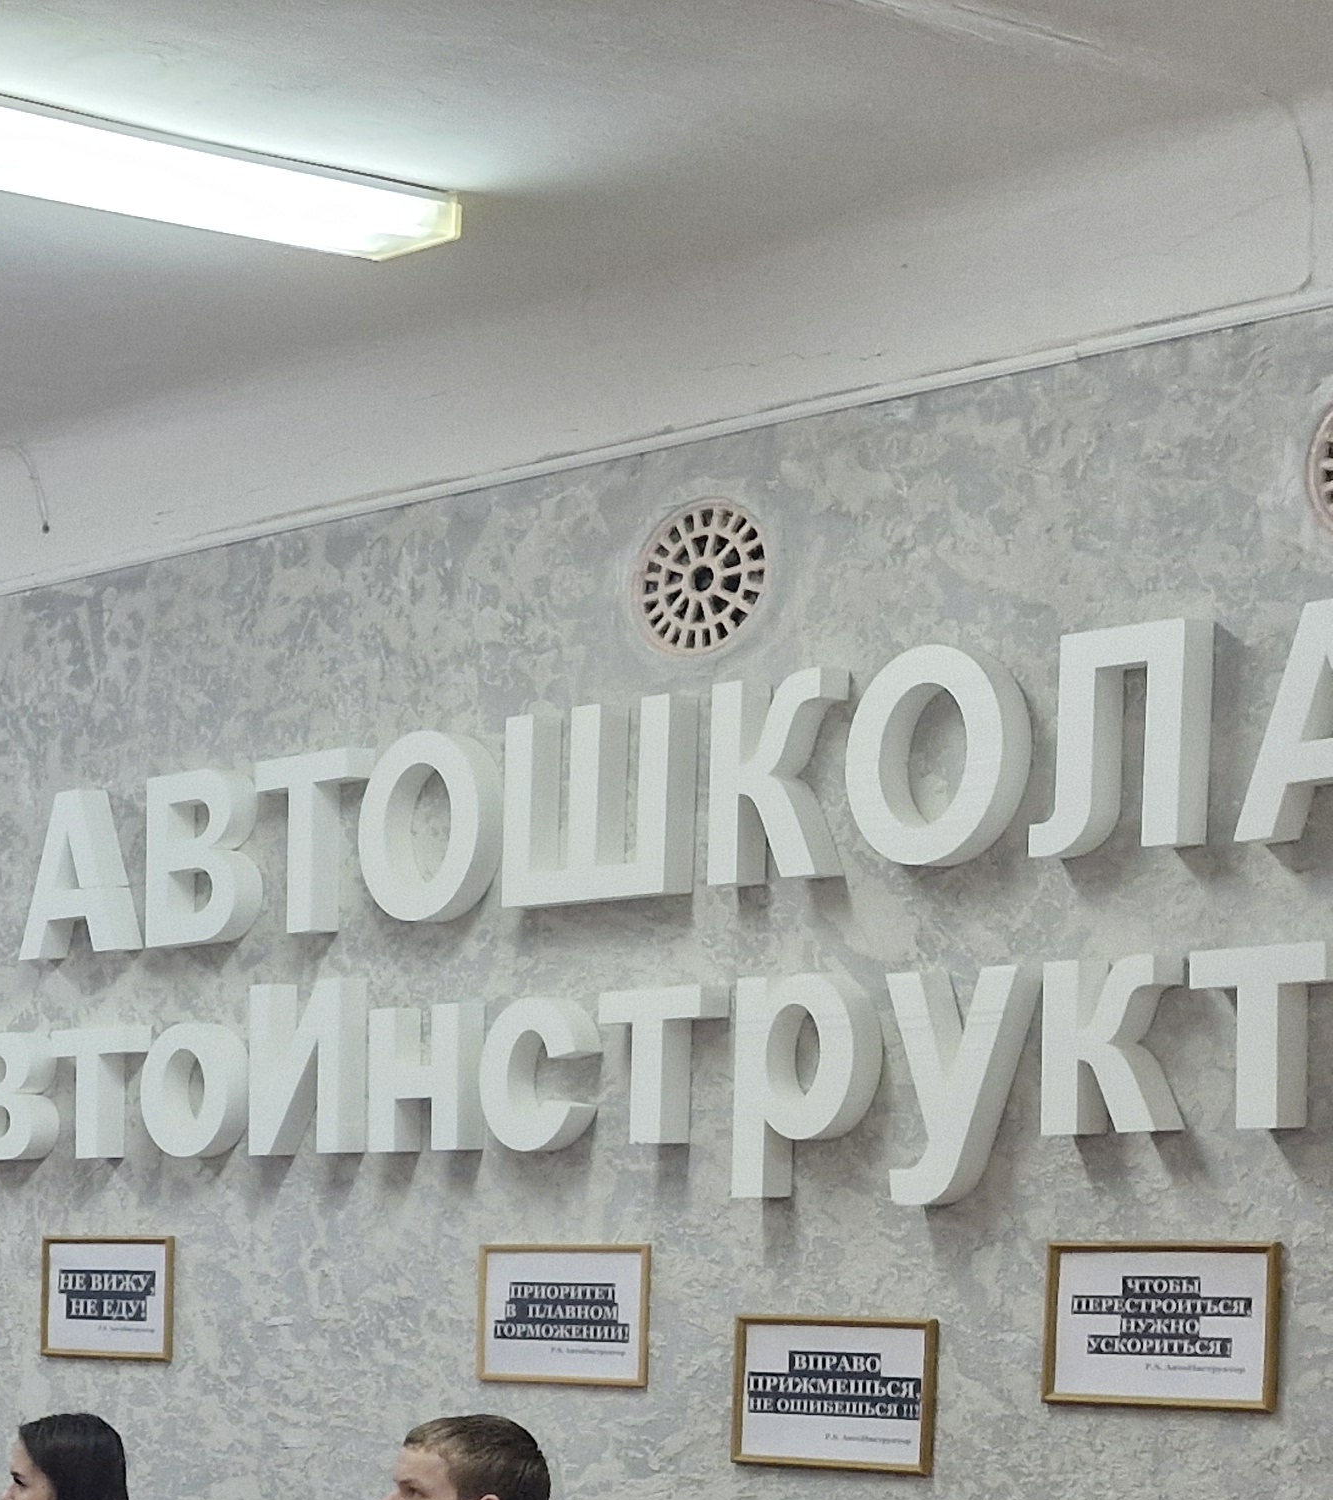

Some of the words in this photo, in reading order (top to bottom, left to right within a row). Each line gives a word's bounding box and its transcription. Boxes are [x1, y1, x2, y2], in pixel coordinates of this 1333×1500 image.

[59, 1272, 87, 1291] НЕ
[90, 1273, 155, 1296] ВИЖУ,
[510, 1284, 615, 1301] ПРИОРИТЕТ
[1126, 1278, 1200, 1295] ЧТОБЫ
[70, 1297, 99, 1318] НЕ
[102, 1298, 147, 1319] ЕДУ!
[506, 1303, 517, 1318] В
[527, 1303, 618, 1321] ПЛАВНОМ
[494, 1322, 629, 1341] ТОРМОЖЕНИИ!
[1121, 1318, 1200, 1334] НУЖНО
[1087, 1337, 1223, 1356] УСКОРИТЬСЯ
[794, 1353, 881, 1373] ВПРАВО
[748, 1375, 921, 1400] ПРИЖМЕШЬСЯ,
[749, 1397, 774, 1412] НЕ
[776, 1399, 899, 1418] ОШИБЕШЬСЯ
